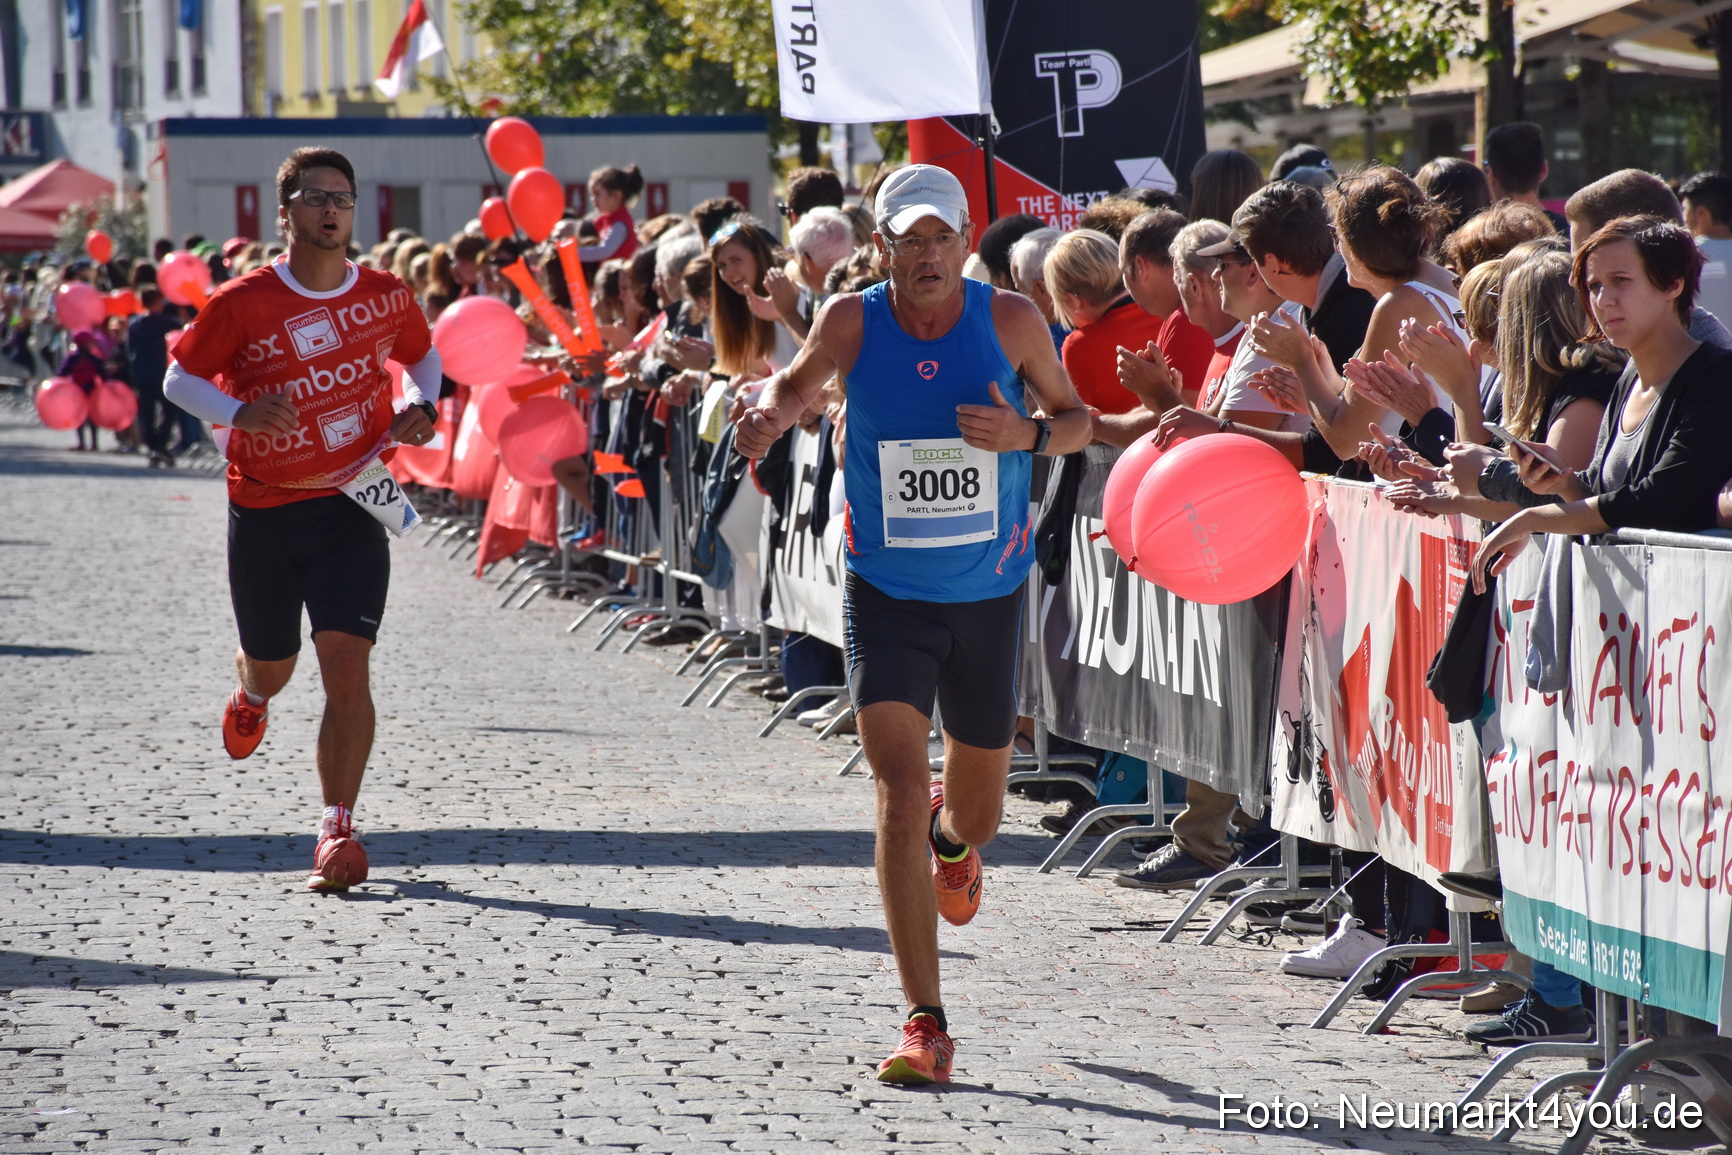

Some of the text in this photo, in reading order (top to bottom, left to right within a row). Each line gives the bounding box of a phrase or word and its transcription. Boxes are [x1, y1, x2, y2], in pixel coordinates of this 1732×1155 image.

[1017, 195, 1056, 216] THE
[288, 311, 328, 331] raumbox
[347, 322, 389, 345] schenken
[320, 407, 358, 425] raumbox
[276, 450, 317, 468] outdoor
[912, 447, 964, 461] BOCK
[898, 467, 981, 502] 3008
[906, 504, 966, 514] PARTL Neumarkt
